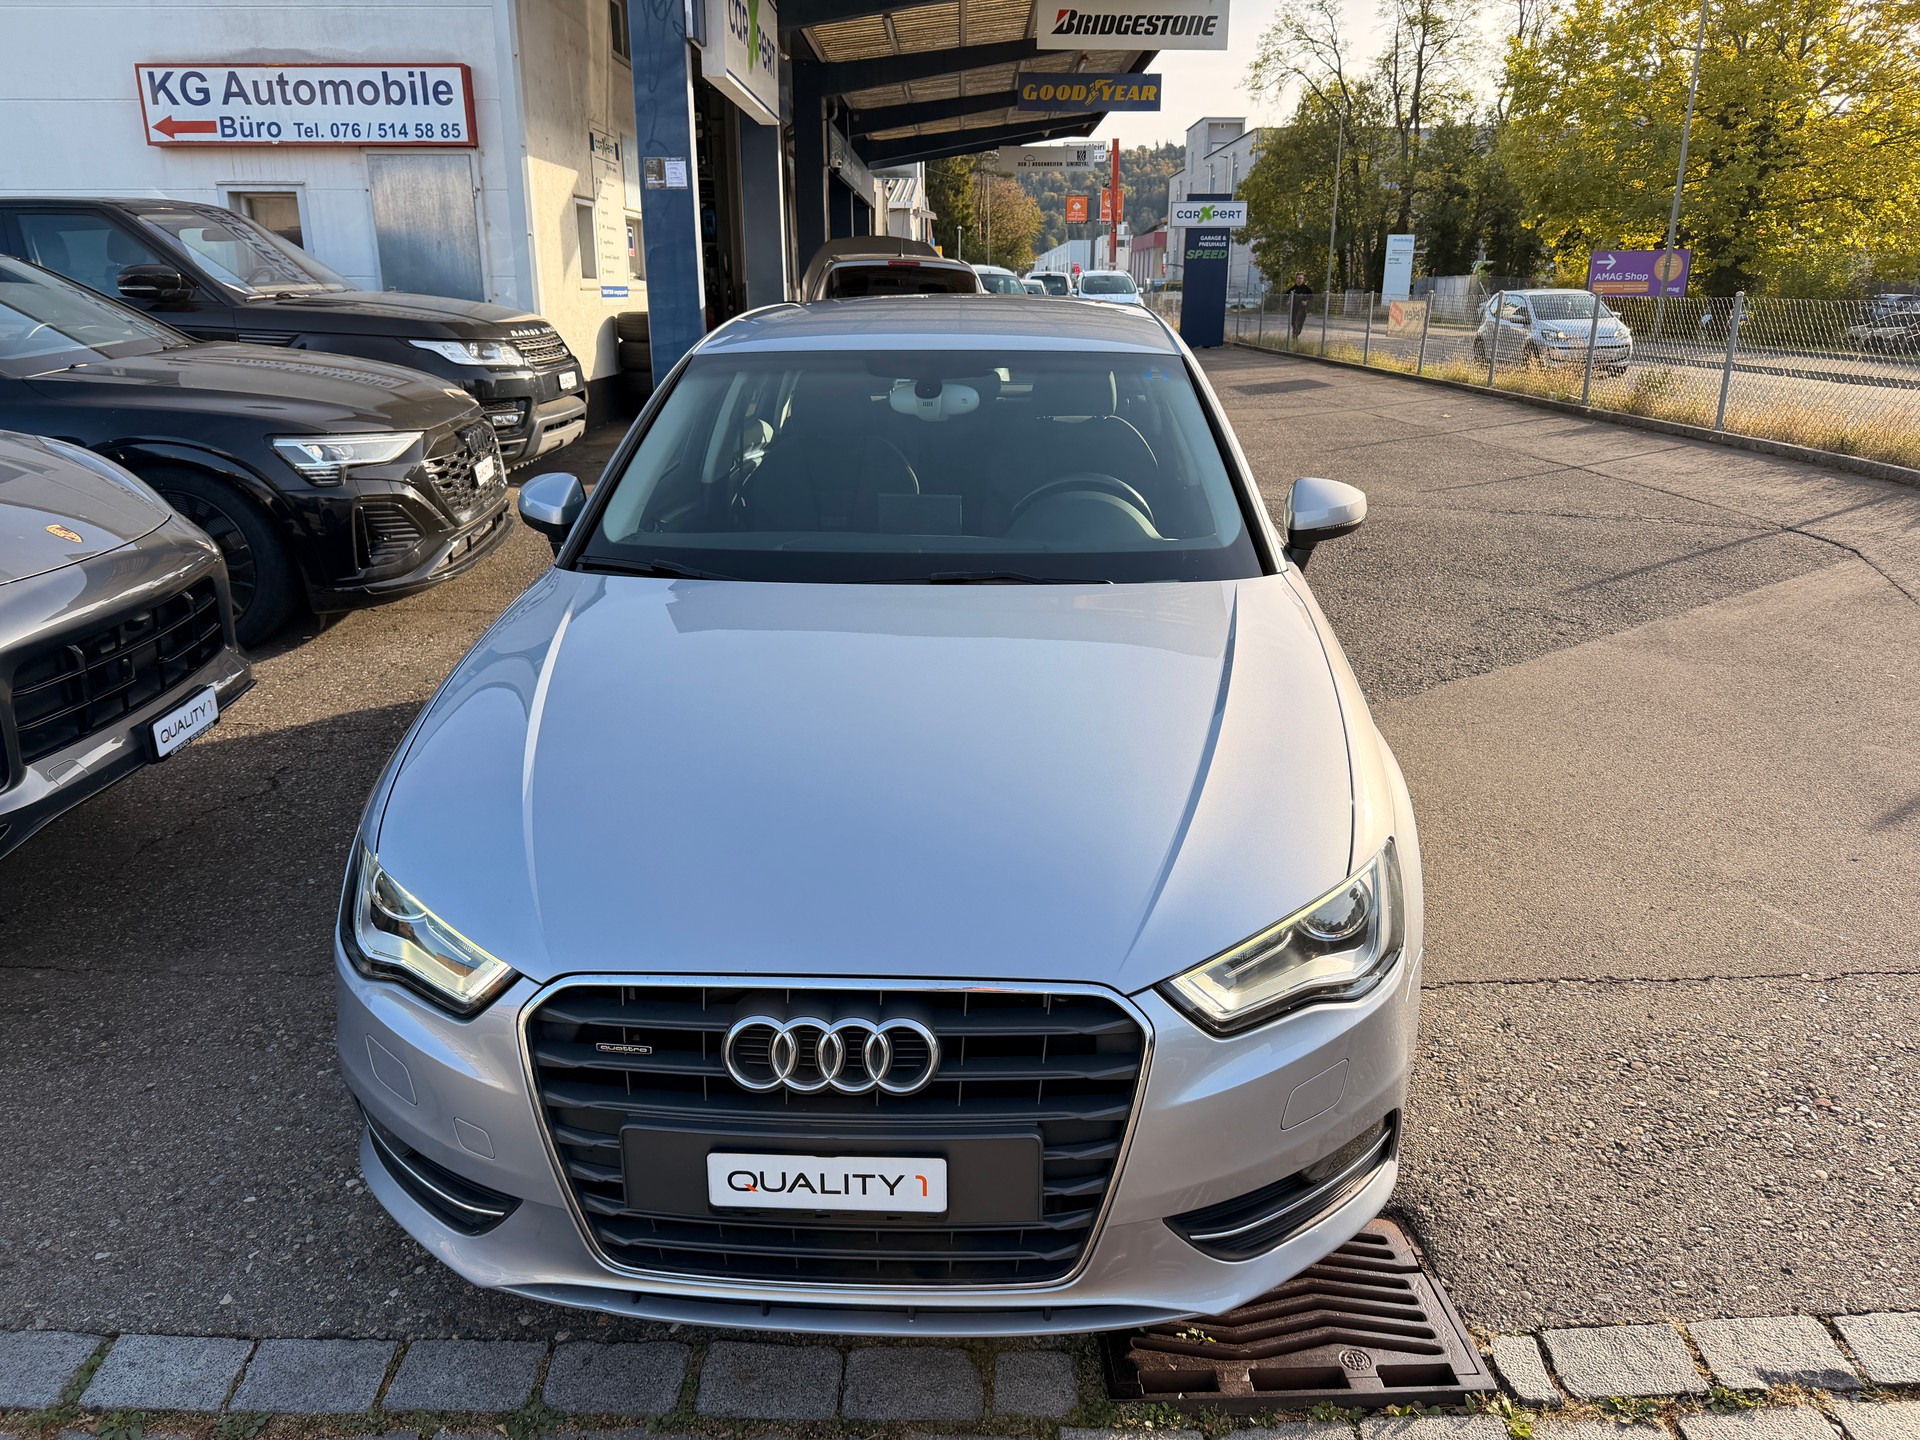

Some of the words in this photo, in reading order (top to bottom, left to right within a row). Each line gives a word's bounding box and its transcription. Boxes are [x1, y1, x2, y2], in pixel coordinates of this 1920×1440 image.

[1051, 9, 1218, 36] BRIDGESTONE
[147, 70, 212, 106] KG
[222, 70, 454, 106] Automobile
[219, 115, 282, 138] Büro
[293, 122, 325, 138] Tel.
[330, 122, 361, 139] 076
[367, 122, 372, 139] /
[378, 122, 409, 138] 514
[414, 122, 435, 138] 58
[440, 122, 461, 138] 85
[1185, 249, 1228, 260] SPEED
[1595, 272, 1623, 281] AMAG
[1624, 272, 1649, 282] Shop
[160, 702, 206, 744] QUALITY
[600, 1045, 648, 1053] quattro
[727, 1170, 905, 1196] QUALITY
[915, 1175, 928, 1197] 1
